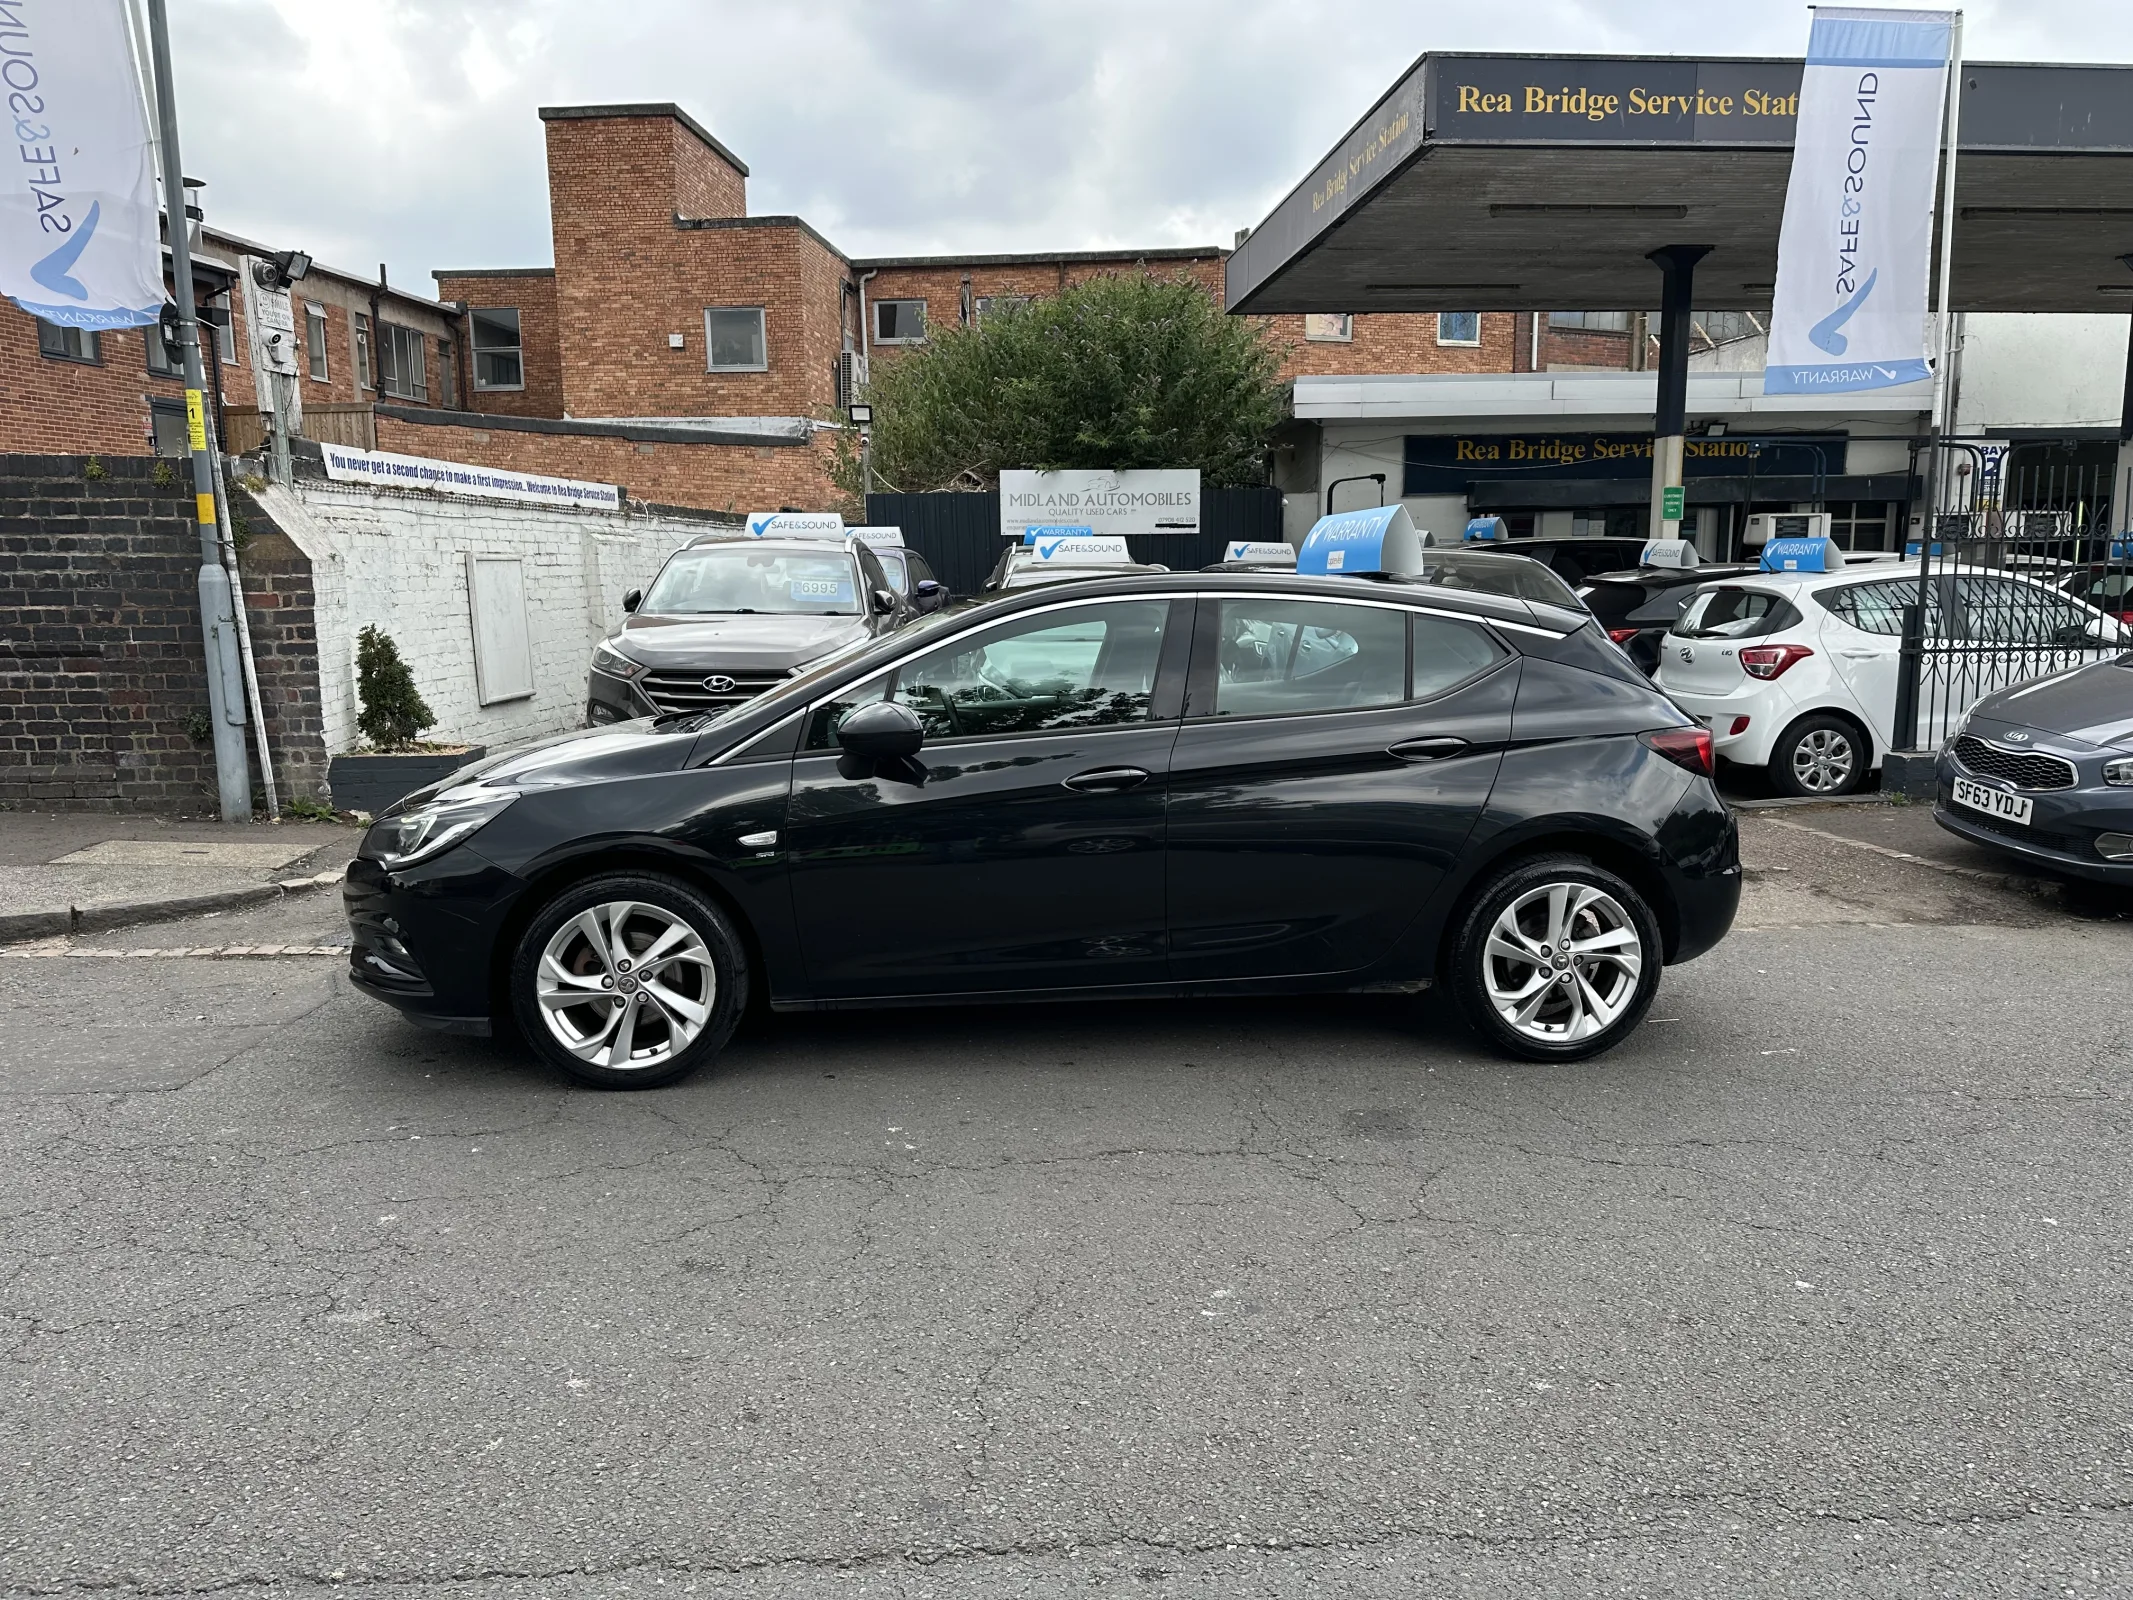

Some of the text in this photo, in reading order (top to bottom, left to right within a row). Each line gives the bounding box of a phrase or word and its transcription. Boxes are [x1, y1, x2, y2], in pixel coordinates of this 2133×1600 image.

[1456, 85, 1513, 113] Rea
[1522, 86, 1619, 121] Bridge
[1628, 87, 1734, 116] Service
[1312, 111, 1409, 213] Rea Bridge Service Station
[1456, 440, 1500, 460] Rea
[1508, 439, 1586, 464] Bridge
[330, 453, 346, 468] You
[347, 457, 370, 472] never
[372, 461, 385, 475] get
[387, 464, 391, 474] a
[393, 463, 418, 478] second
[420, 466, 444, 481] chance
[446, 470, 453, 482] to
[454, 472, 472, 485] make
[472, 476, 477, 486] a
[478, 474, 491, 487] first
[526, 480, 552, 494] Welcome
[552, 485, 557, 496] to
[558, 484, 567, 496] Rea
[567, 487, 584, 499] Bridge
[584, 488, 600, 499] Service
[600, 490, 616, 502] Station
[1009, 492, 1192, 507] MIDLAND AUTOMOBILES
[1048, 508, 1127, 516] QUALITY USED CARS
[771, 520, 837, 531] SAFE&SOUND
[1042, 528, 1089, 536] WARRANTY
[1323, 515, 1388, 542] WARRANTY
[1058, 544, 1122, 553] SAFE&SOUND
[1777, 542, 1822, 556] WARRANTY
[1958, 780, 2027, 819] SF63 YDJ
